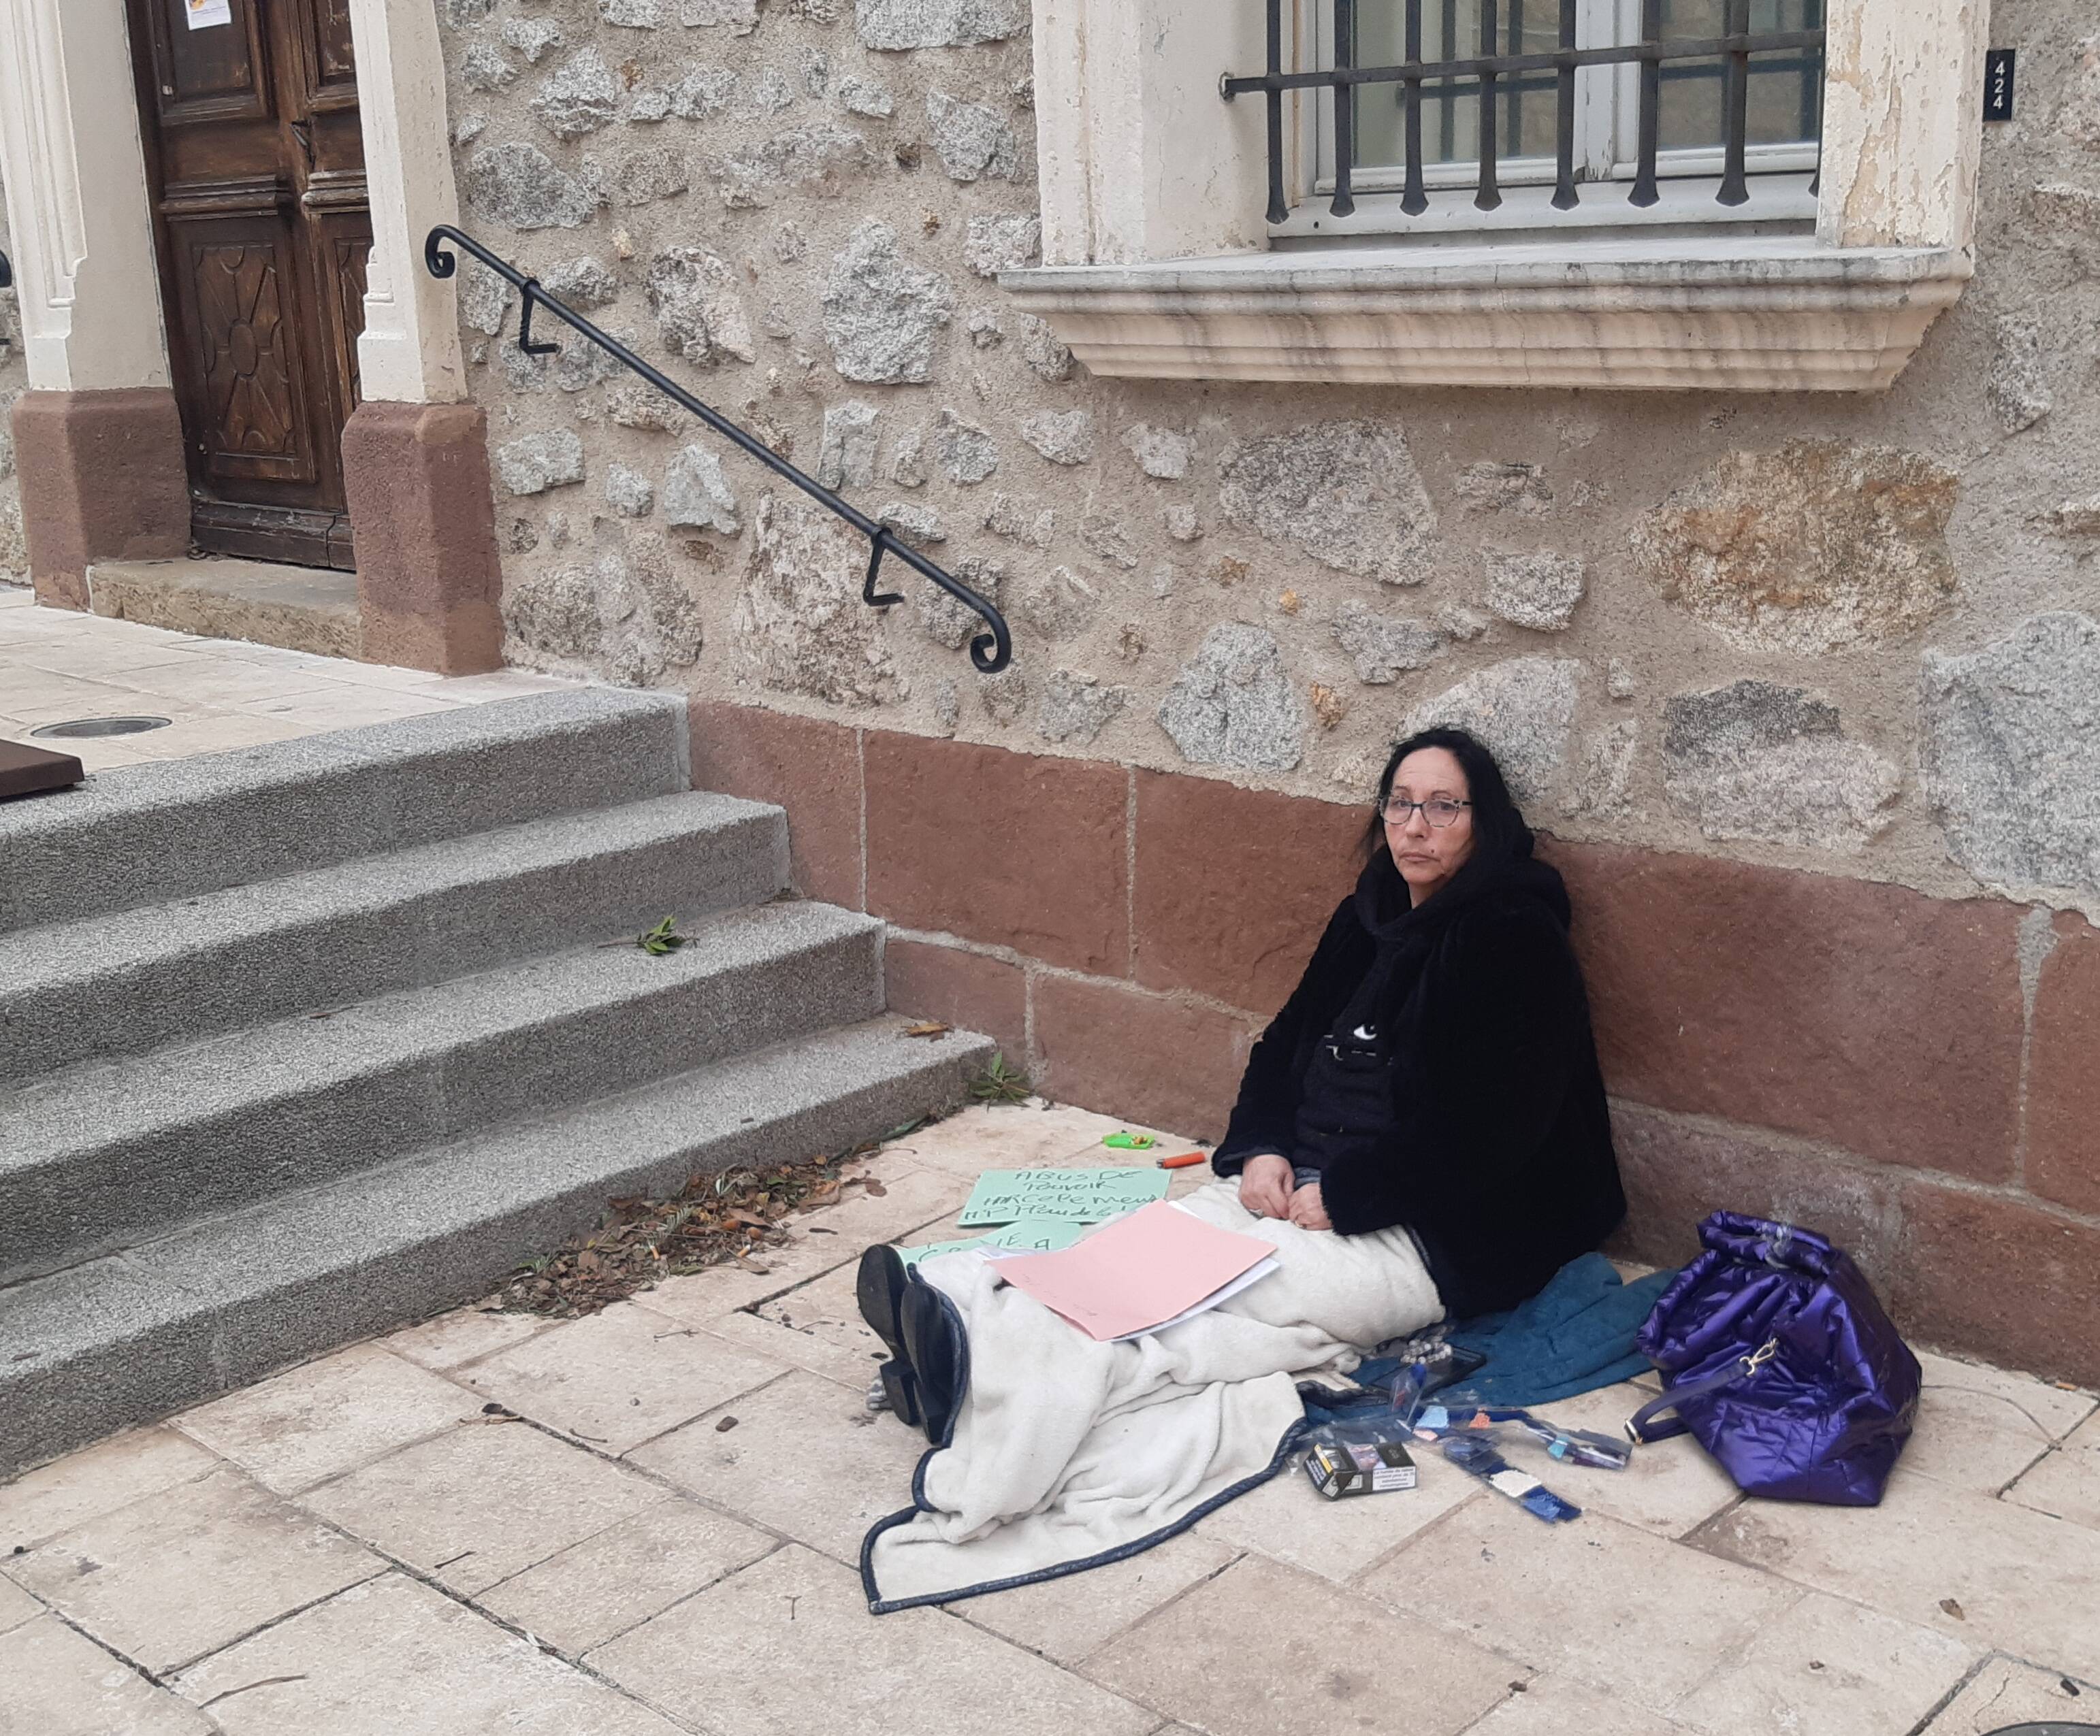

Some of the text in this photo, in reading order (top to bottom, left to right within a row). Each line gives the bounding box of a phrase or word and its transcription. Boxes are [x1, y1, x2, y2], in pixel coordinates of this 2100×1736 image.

[1993, 61, 2005, 109] 424
[1015, 1170, 1143, 1181] ABUS DE
